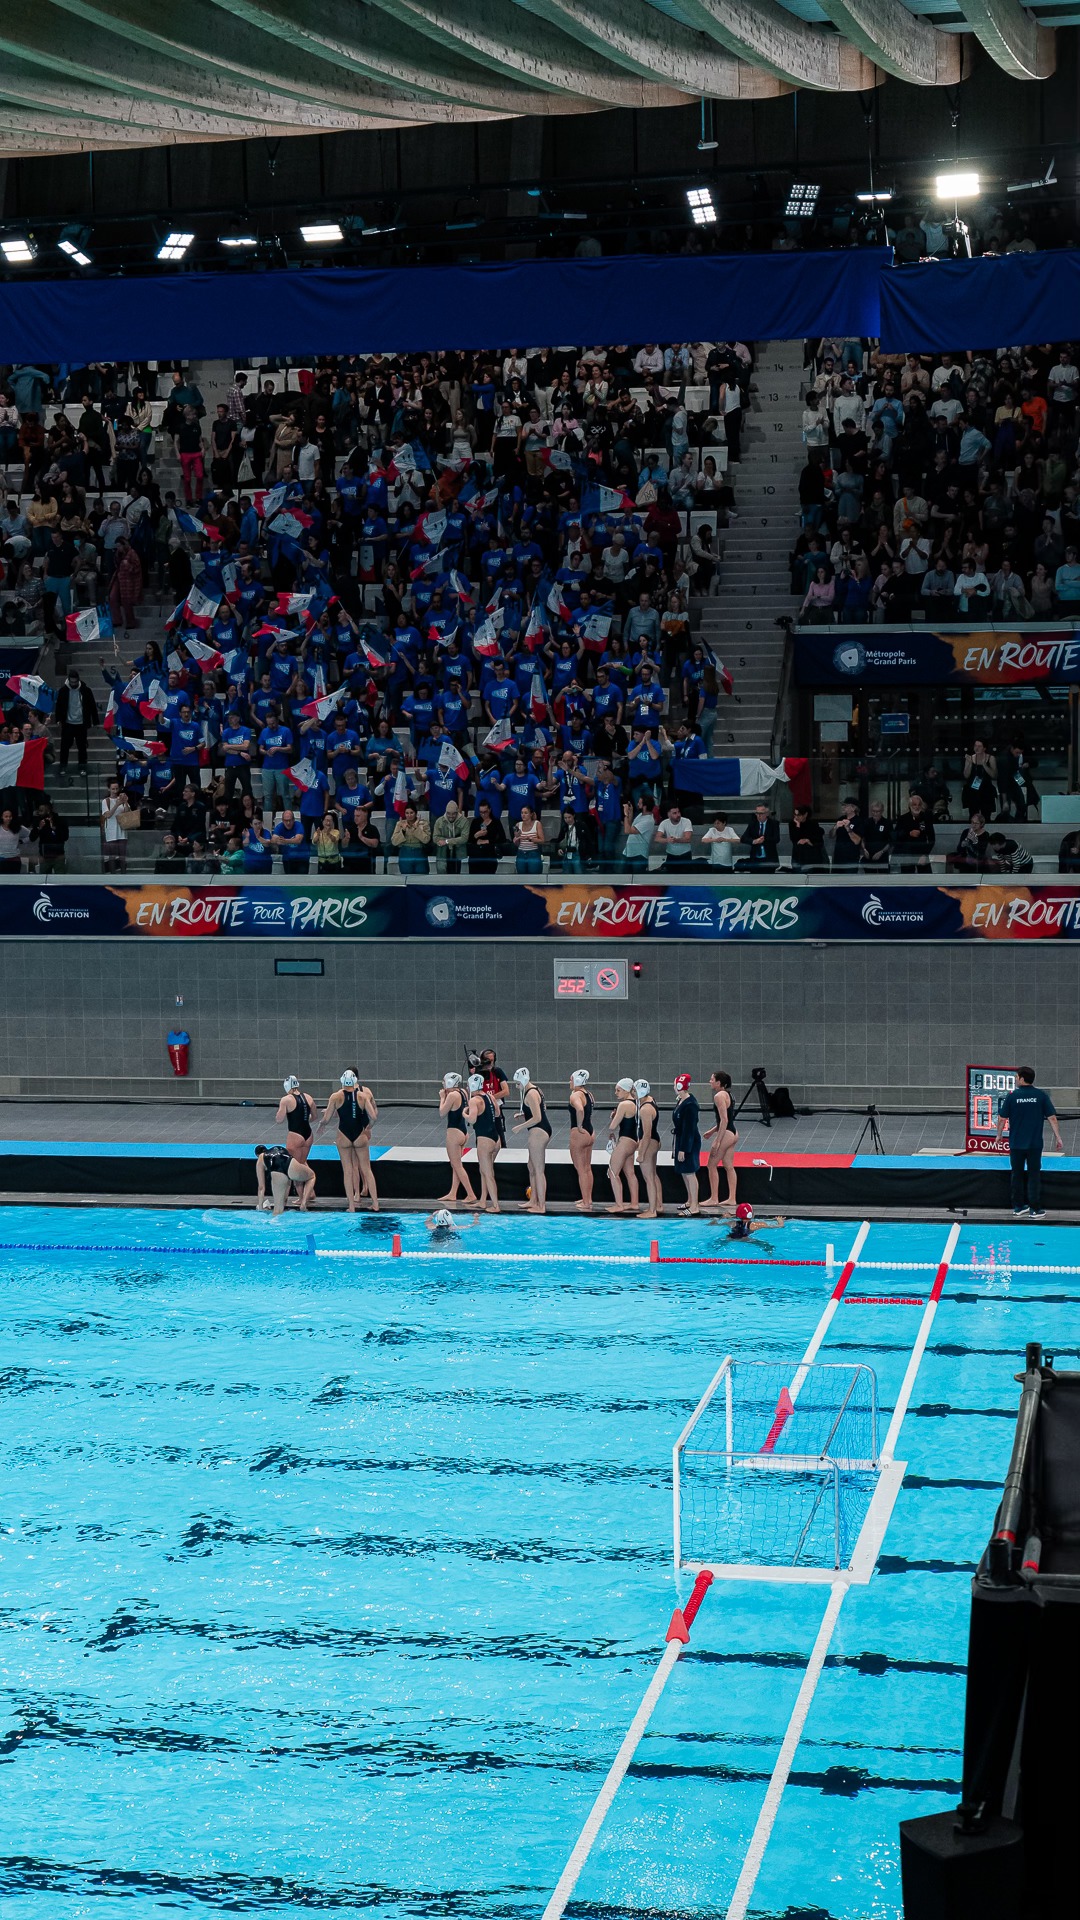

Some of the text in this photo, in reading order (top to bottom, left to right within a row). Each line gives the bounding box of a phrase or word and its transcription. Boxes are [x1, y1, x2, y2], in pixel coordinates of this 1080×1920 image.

[774, 364, 784, 372] 14
[208, 380, 218, 389] 14
[768, 394, 779, 402] 13
[773, 424, 783, 432] 12
[770, 454, 778, 463] 11
[762, 486, 775, 495] 10
[760, 518, 768, 528] 9
[756, 552, 762, 561] 8
[752, 586, 757, 595] 7
[746, 621, 752, 630] 6
[866, 650, 906, 659] Métropole
[963, 640, 1080, 672] EN ROUTE
[740, 657, 746, 667] 5
[874, 658, 897, 666] Grand
[727, 733, 735, 743] 3
[136, 895, 369, 930] EN ROUTE POUR PARIS
[454, 904, 492, 913] Métropole
[557, 896, 799, 931] EN ROUTE POUR PARIS
[878, 914, 924, 922] NATATION
[972, 901, 1004, 928] EN
[984, 1074, 1016, 1090] 0:00
[980, 1140, 1010, 1150] OMEG
